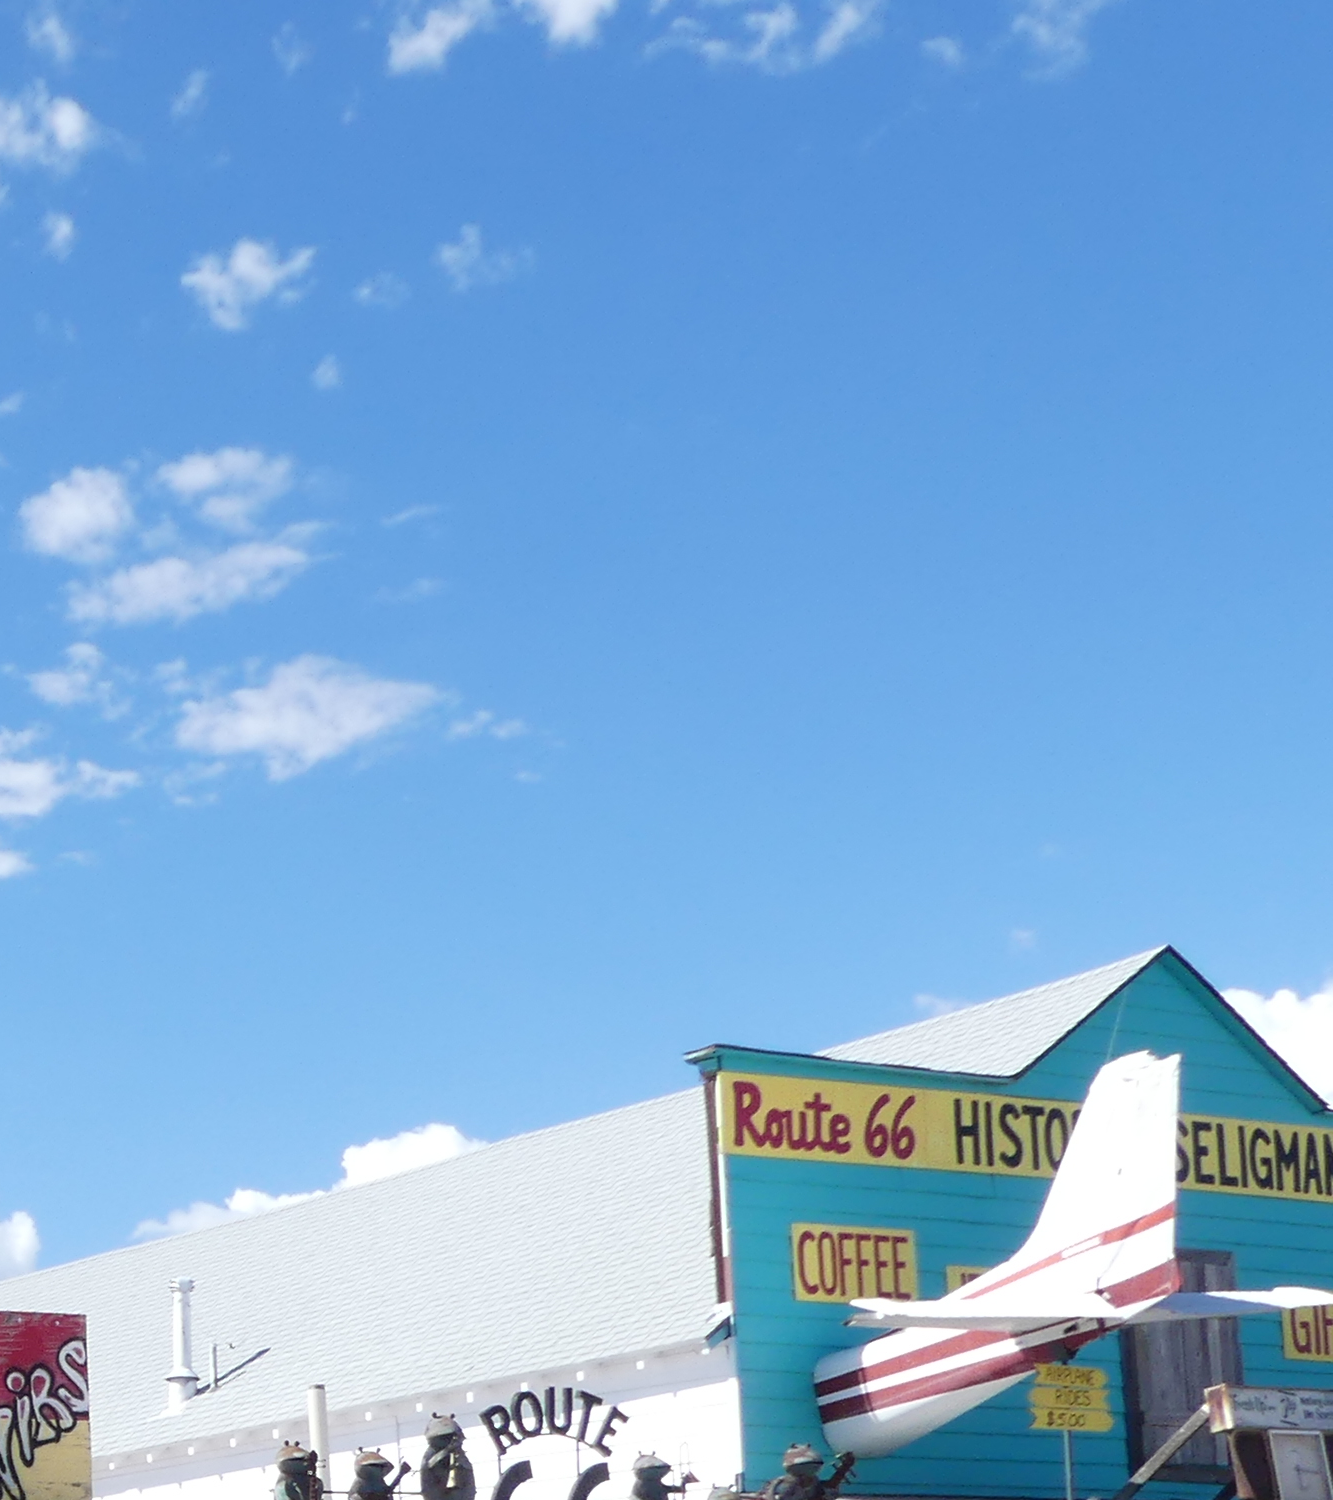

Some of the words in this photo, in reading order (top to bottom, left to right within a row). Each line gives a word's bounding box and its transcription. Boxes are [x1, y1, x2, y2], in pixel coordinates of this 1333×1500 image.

[732, 1080, 852, 1157] Route
[863, 1093, 918, 1161] 66
[952, 1097, 1081, 1173] HISTO
[797, 1229, 913, 1302] COFFEE
[479, 1386, 631, 1457] ROUTE
[1054, 1388, 1092, 1408] RIDES
